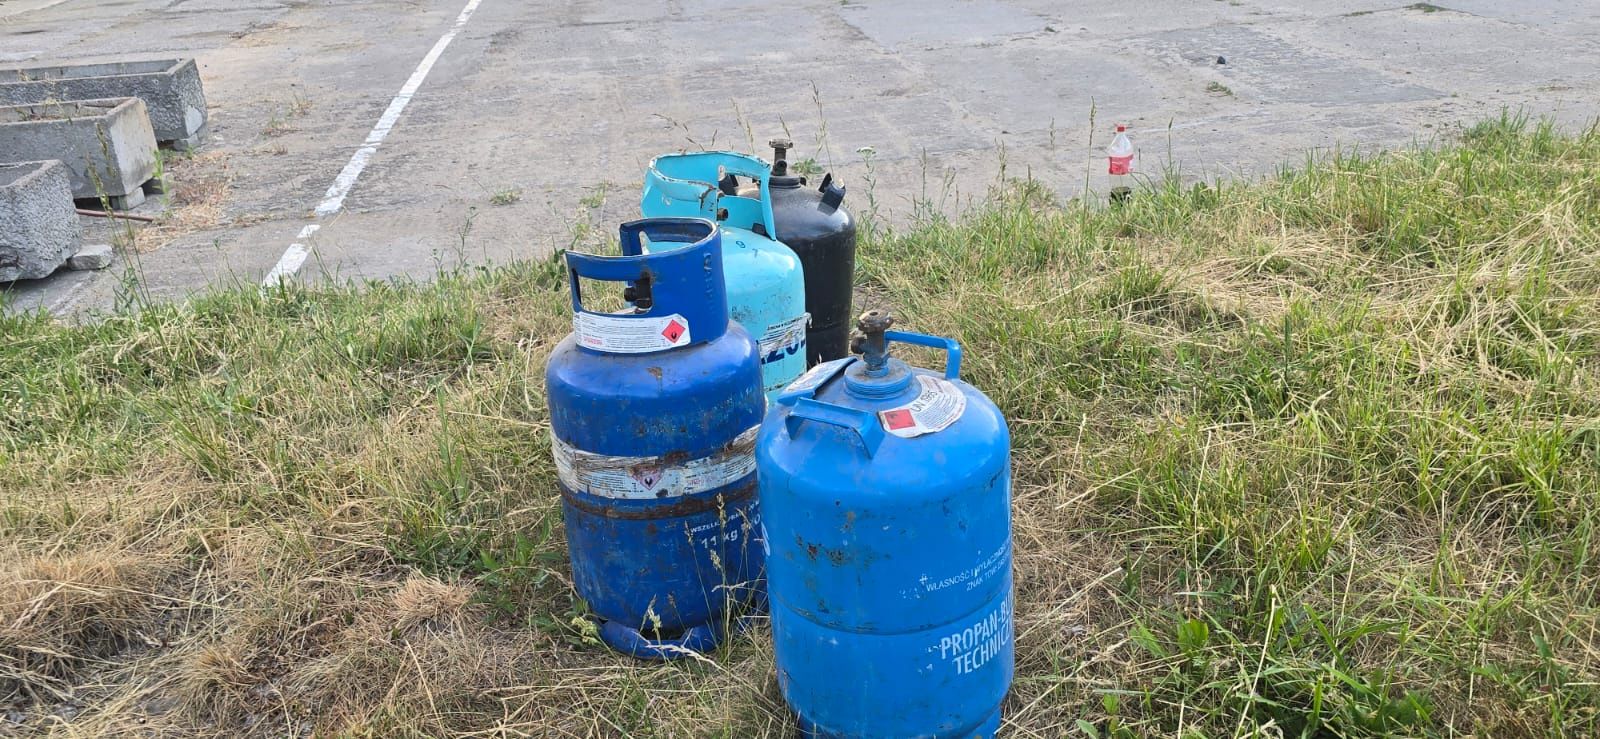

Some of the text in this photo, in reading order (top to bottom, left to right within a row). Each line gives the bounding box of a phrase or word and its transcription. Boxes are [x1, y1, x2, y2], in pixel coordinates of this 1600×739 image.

[910, 401, 926, 412] UN
[701, 535, 717, 549] 11
[967, 576, 983, 592] ZNAK
